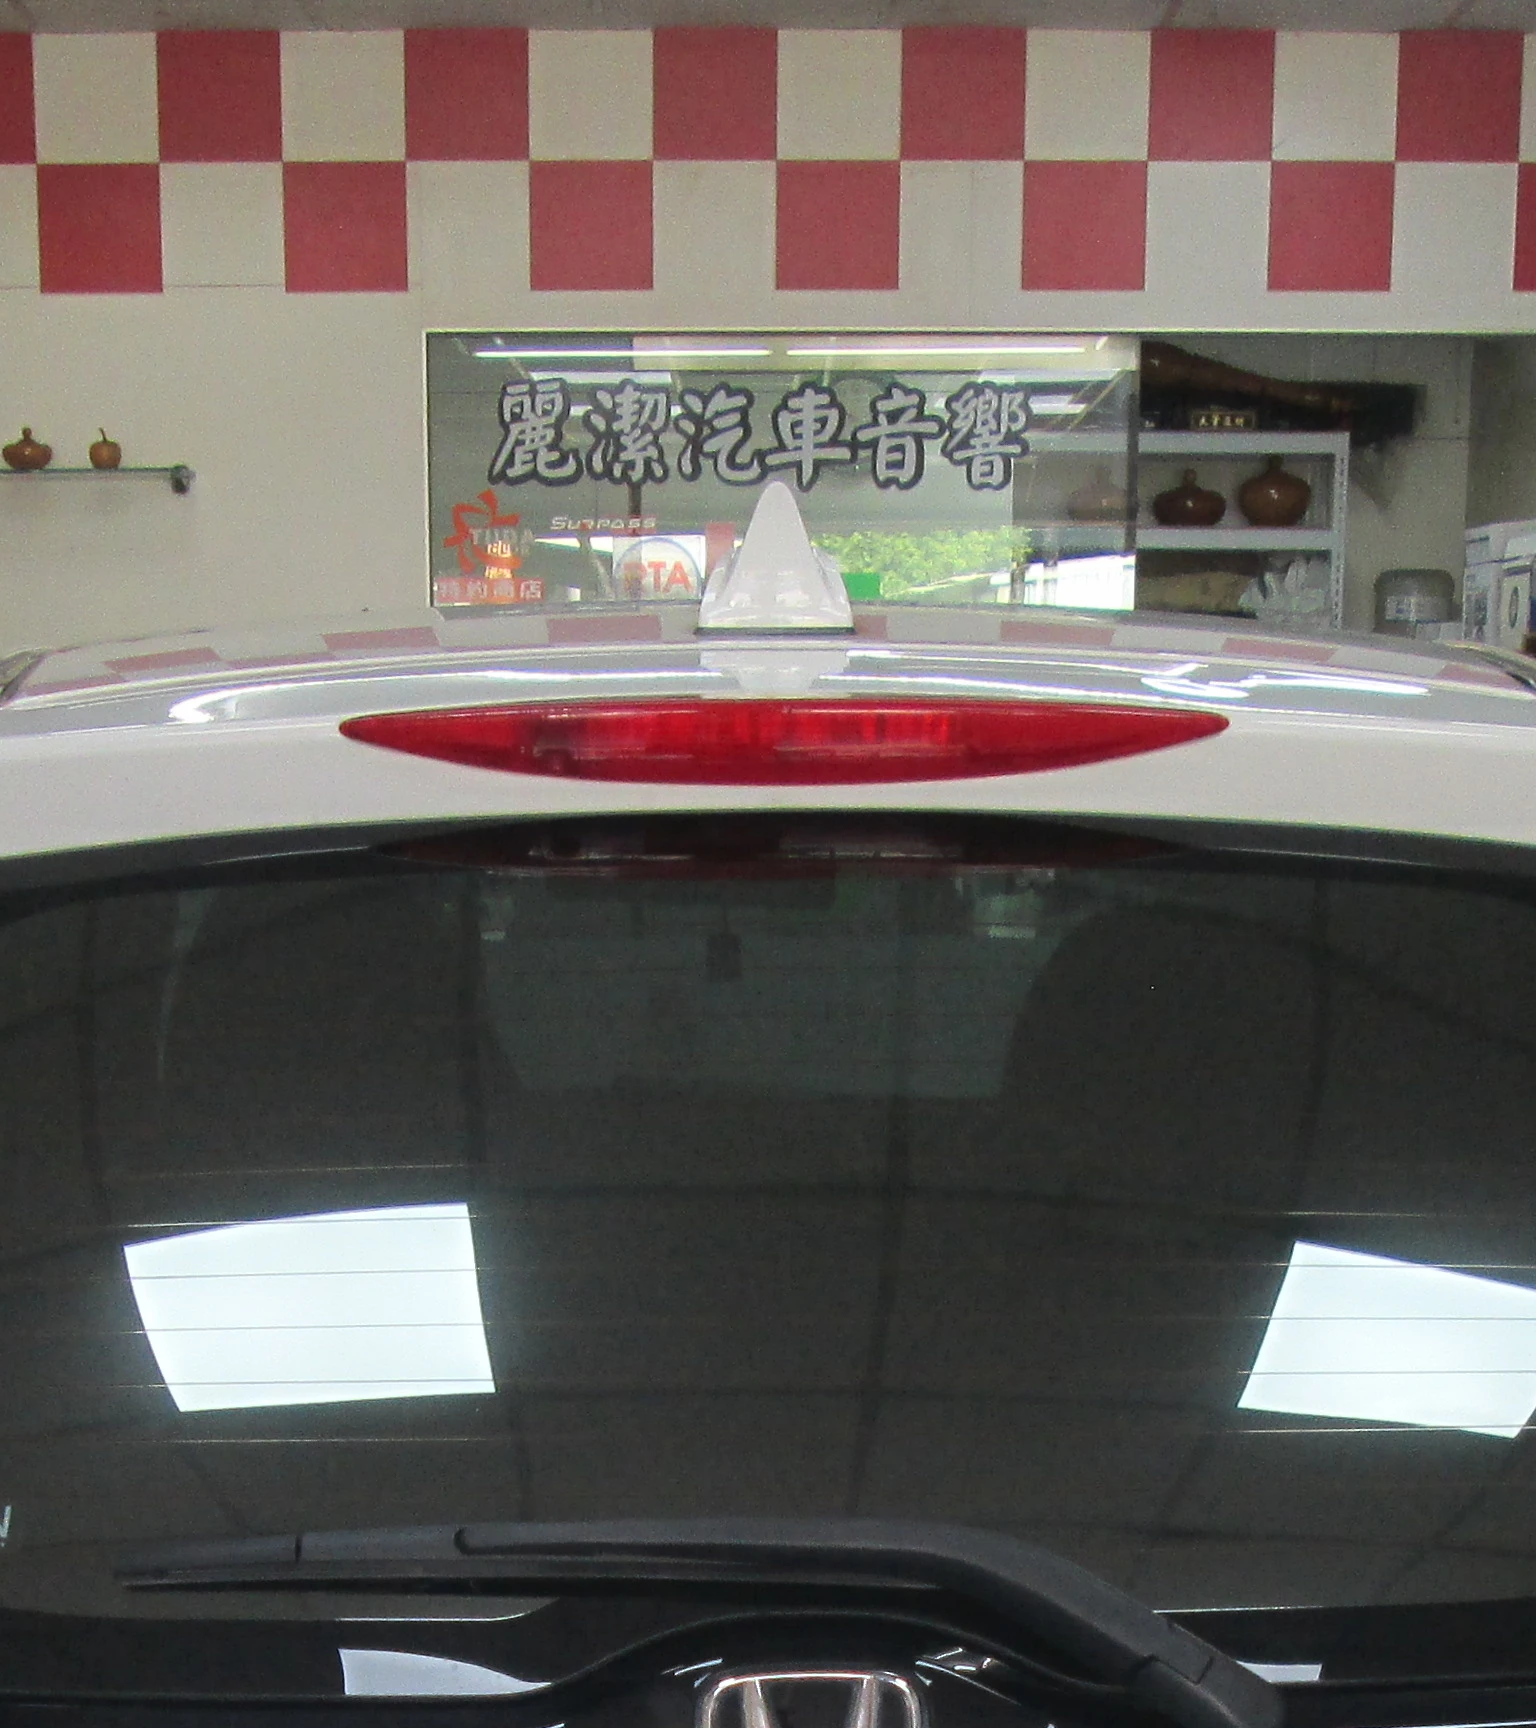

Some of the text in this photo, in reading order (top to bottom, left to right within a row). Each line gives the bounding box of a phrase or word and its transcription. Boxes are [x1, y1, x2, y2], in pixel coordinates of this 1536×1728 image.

[488, 378, 1030, 491] 麗潔汽車音響
